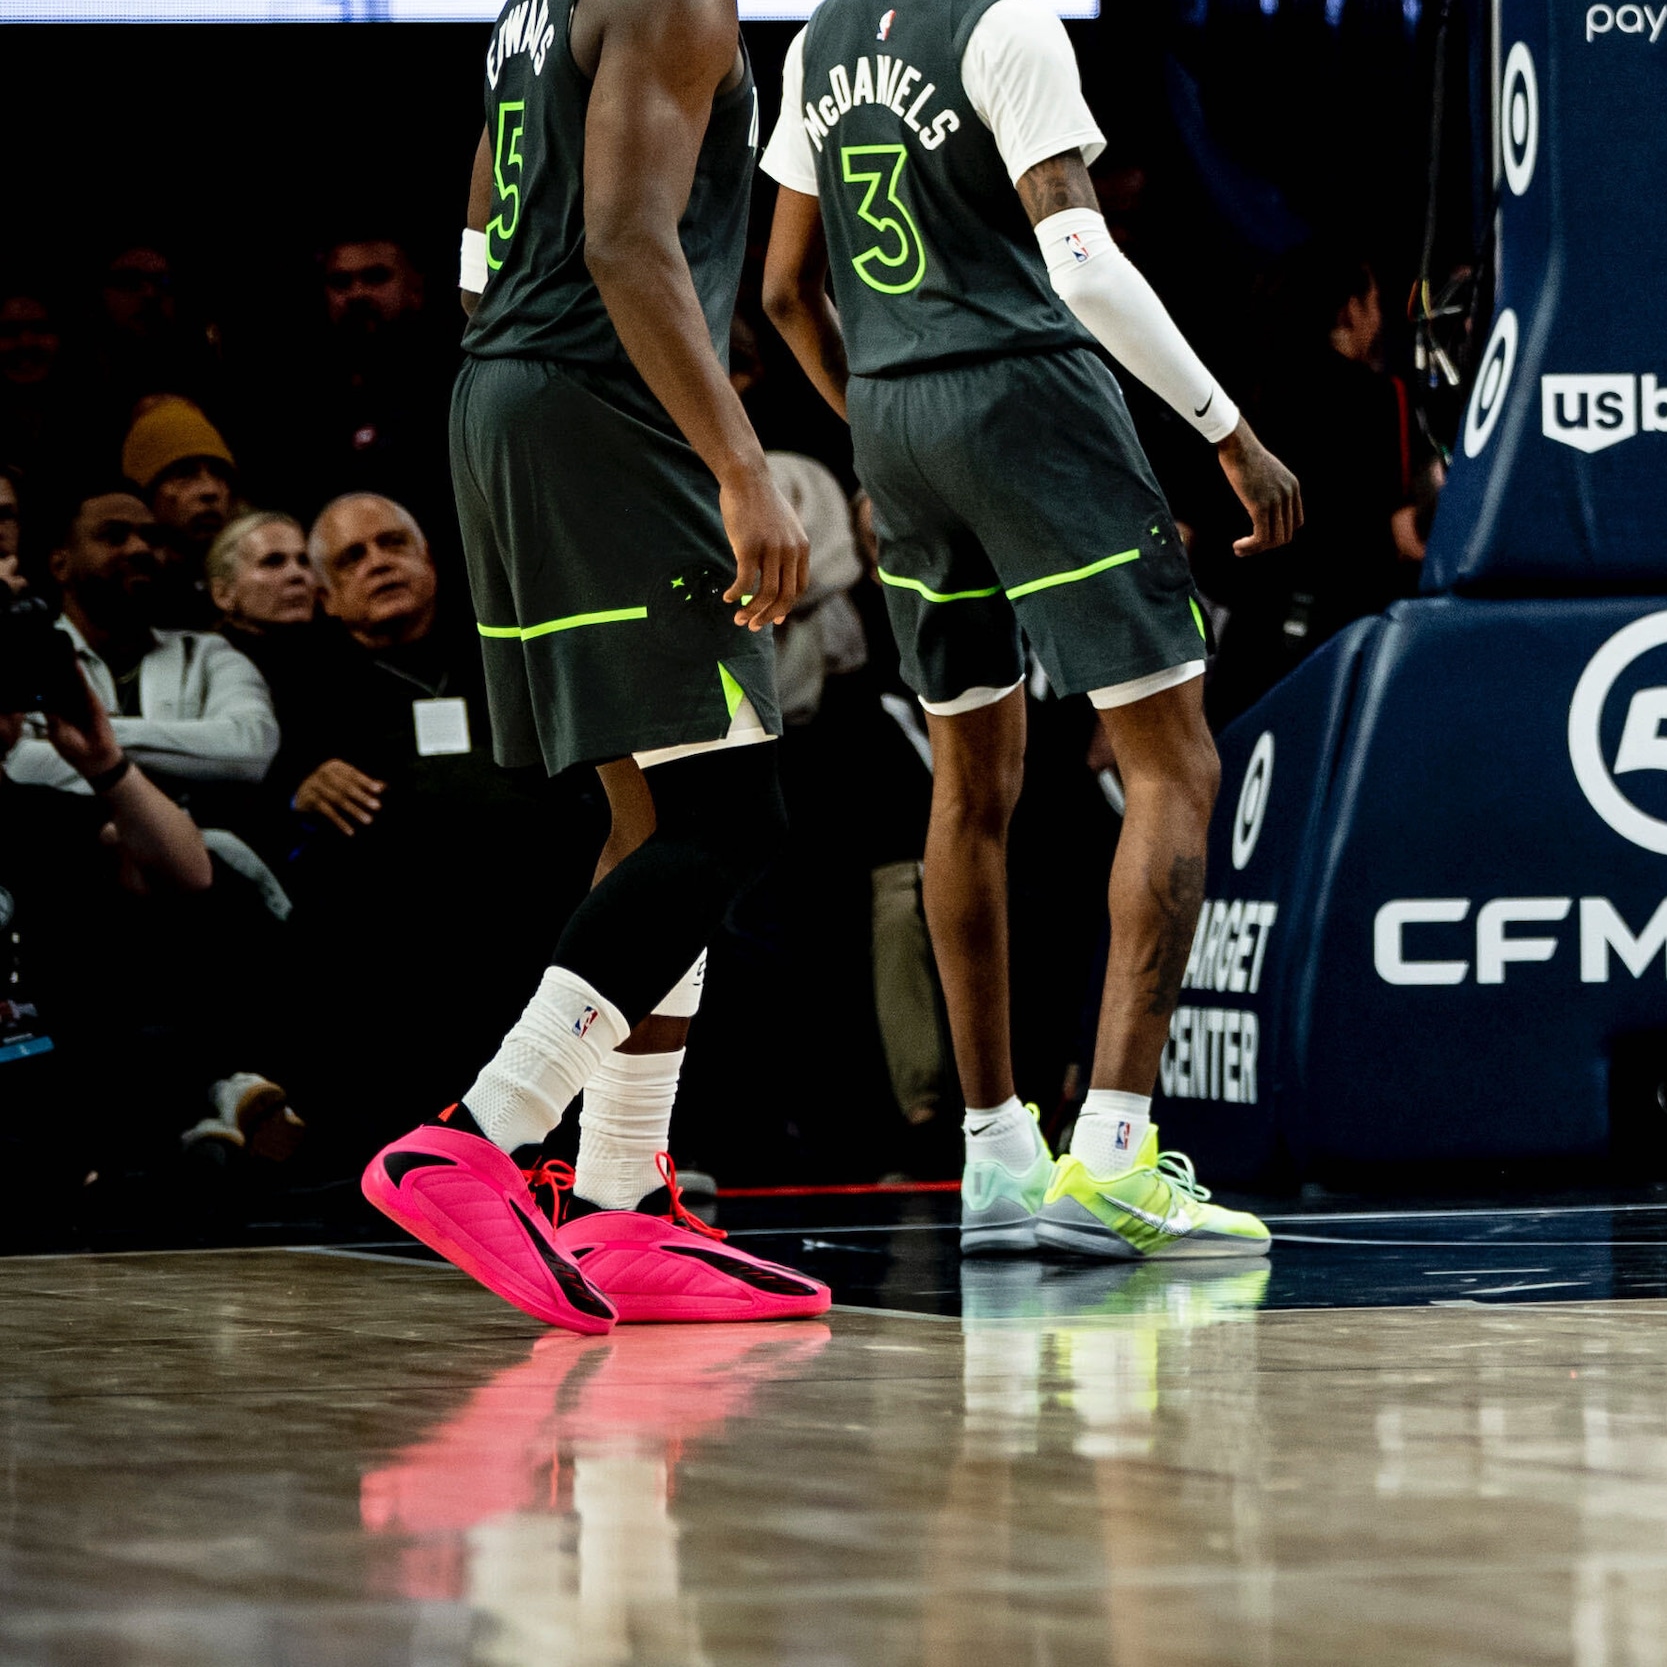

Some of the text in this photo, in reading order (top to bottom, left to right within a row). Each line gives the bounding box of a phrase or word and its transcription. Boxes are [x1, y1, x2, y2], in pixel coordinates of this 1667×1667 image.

[803, 54, 961, 152] McDANIELS
[485, 100, 525, 271] 5
[840, 144, 927, 295] 3
[1180, 898, 1280, 995] ARGET
[1159, 1005, 1260, 1105] CENTER
